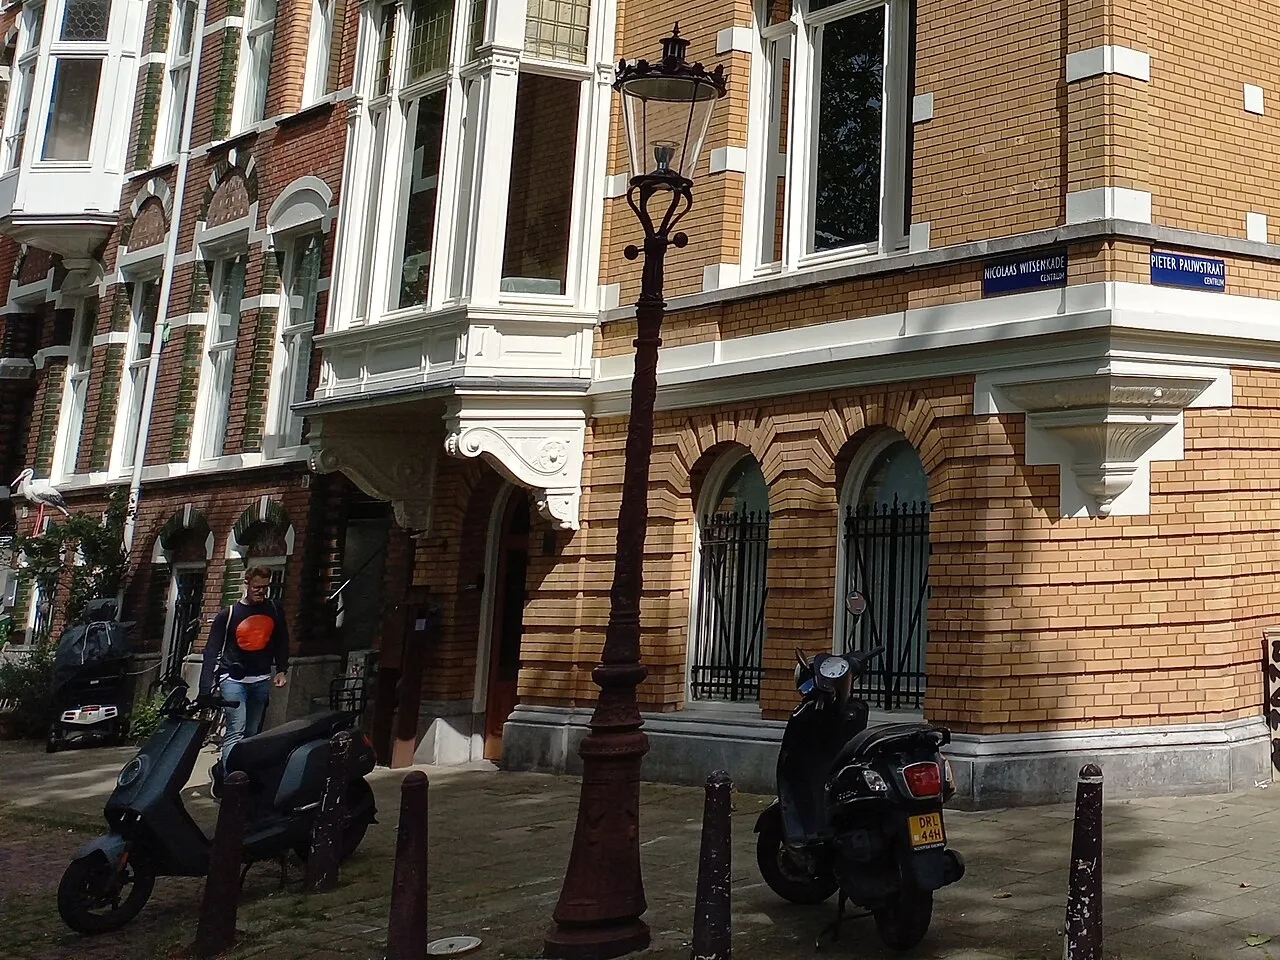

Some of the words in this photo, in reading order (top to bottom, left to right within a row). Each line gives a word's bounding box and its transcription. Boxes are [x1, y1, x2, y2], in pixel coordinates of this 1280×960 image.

[984, 263, 1017, 280] NICOLAAS
[1019, 256, 1065, 275] WITSENKADE
[1151, 255, 1177, 271] PIETER
[1179, 259, 1224, 276] PAUWSTRAAT
[1040, 272, 1065, 282] CENTRUM
[1203, 276, 1225, 287] CENTRUM
[919, 815, 939, 829] DRL
[921, 828, 941, 842] 44H
